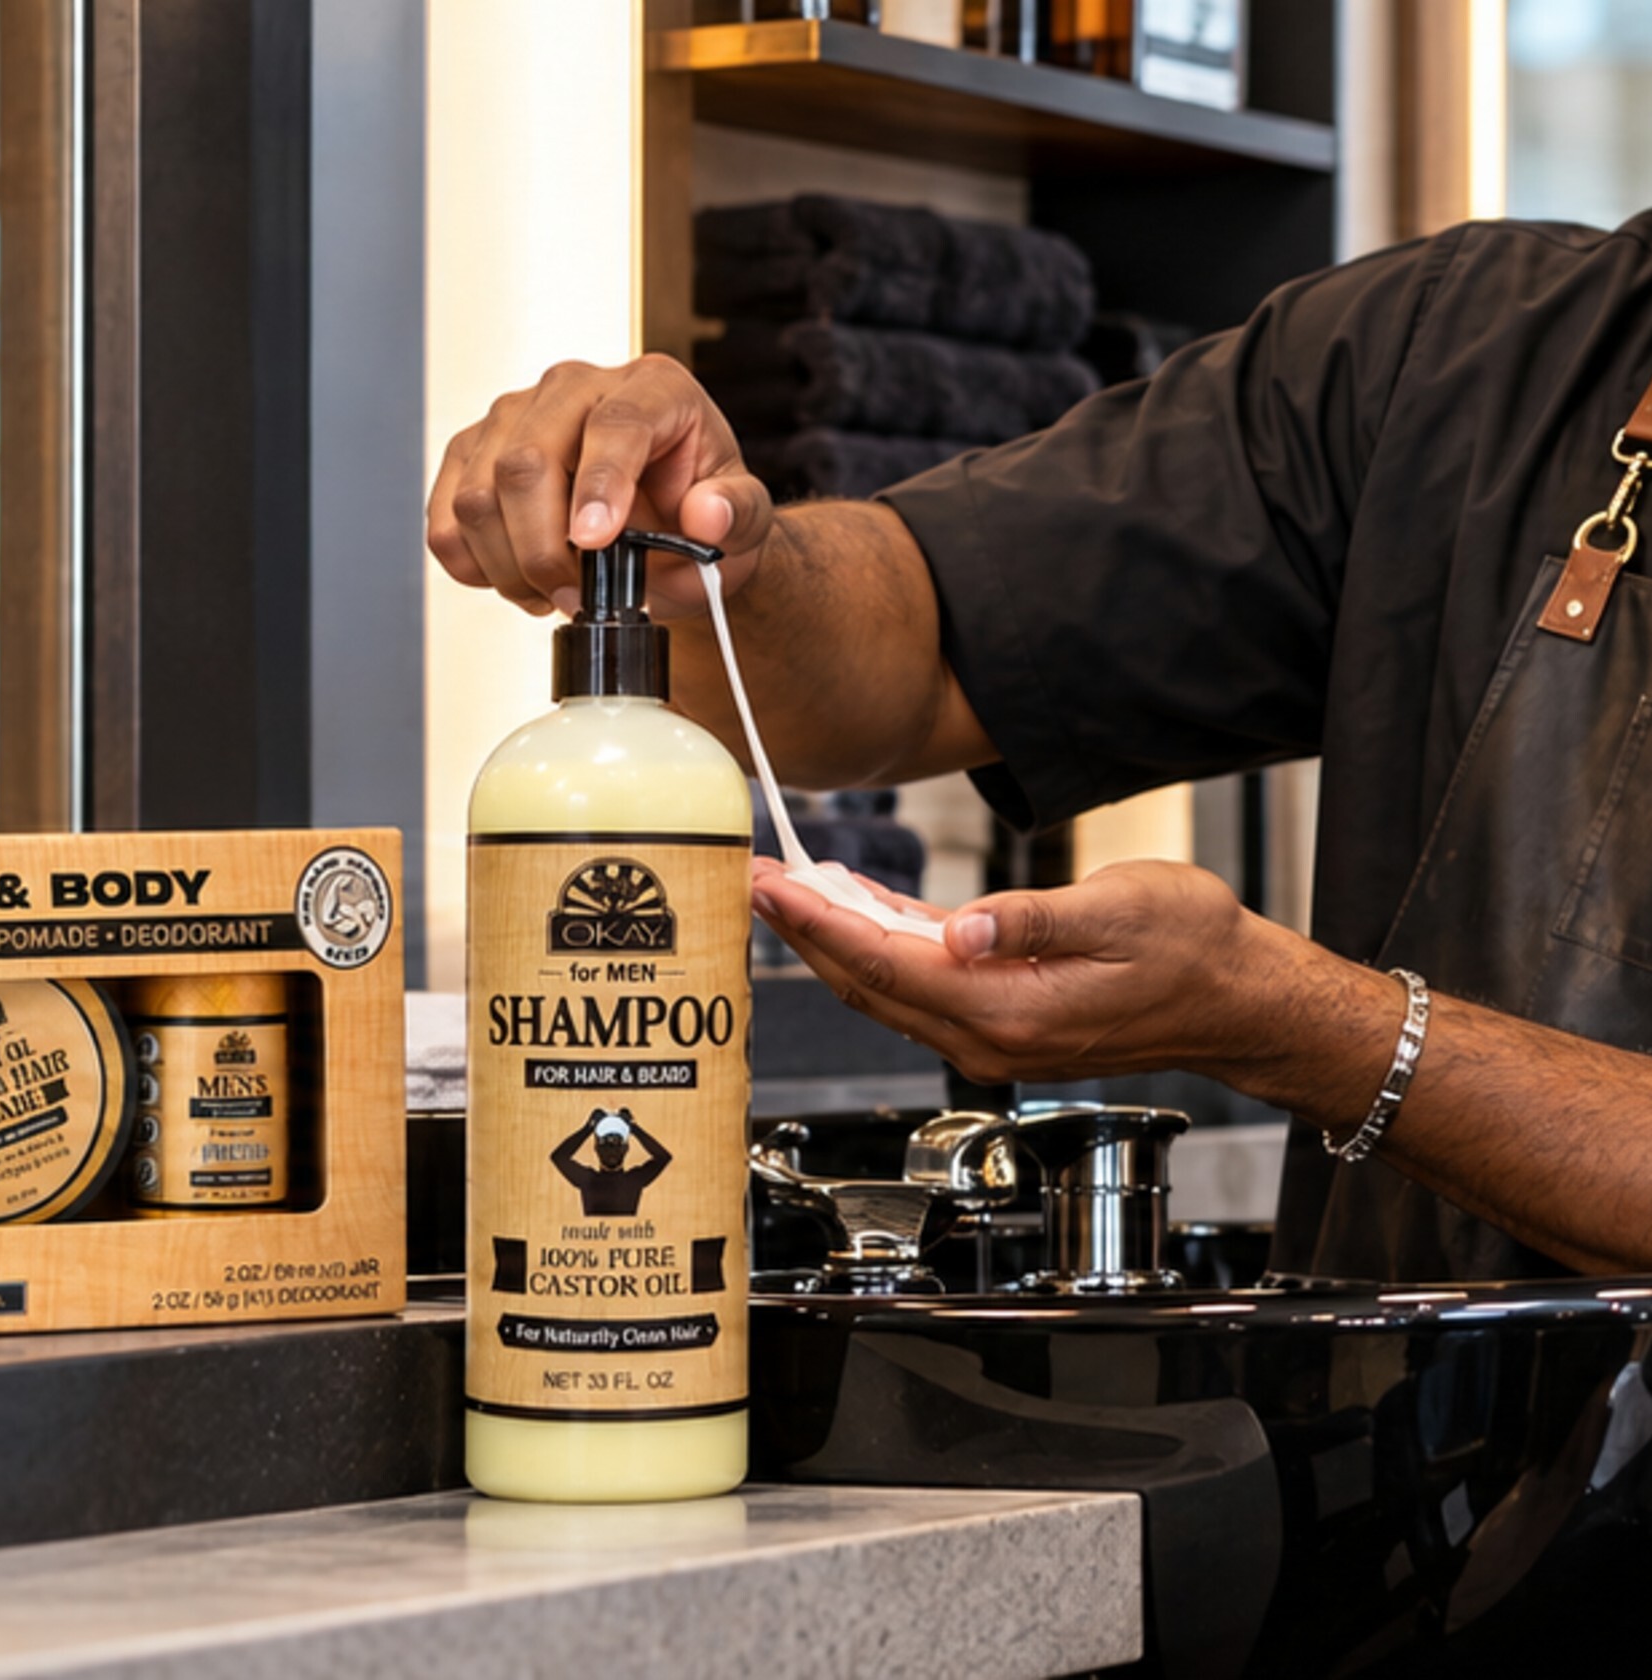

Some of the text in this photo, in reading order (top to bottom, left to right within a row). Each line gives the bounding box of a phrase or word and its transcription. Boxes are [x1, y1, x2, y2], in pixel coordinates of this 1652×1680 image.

[50, 869, 212, 907] BODY
[120, 920, 273, 947] DEODORANT
[561, 920, 663, 947] OKAY
[569, 961, 656, 983] for MEN
[488, 993, 735, 1048] SHAMPOO
[534, 1065, 569, 1084] FOR
[573, 1065, 618, 1085] HAIR
[608, 1245, 677, 1269] PURE
[529, 1272, 688, 1297] CASTOR OIL
[542, 1371, 583, 1390] NET
[646, 1370, 675, 1390] OZ
